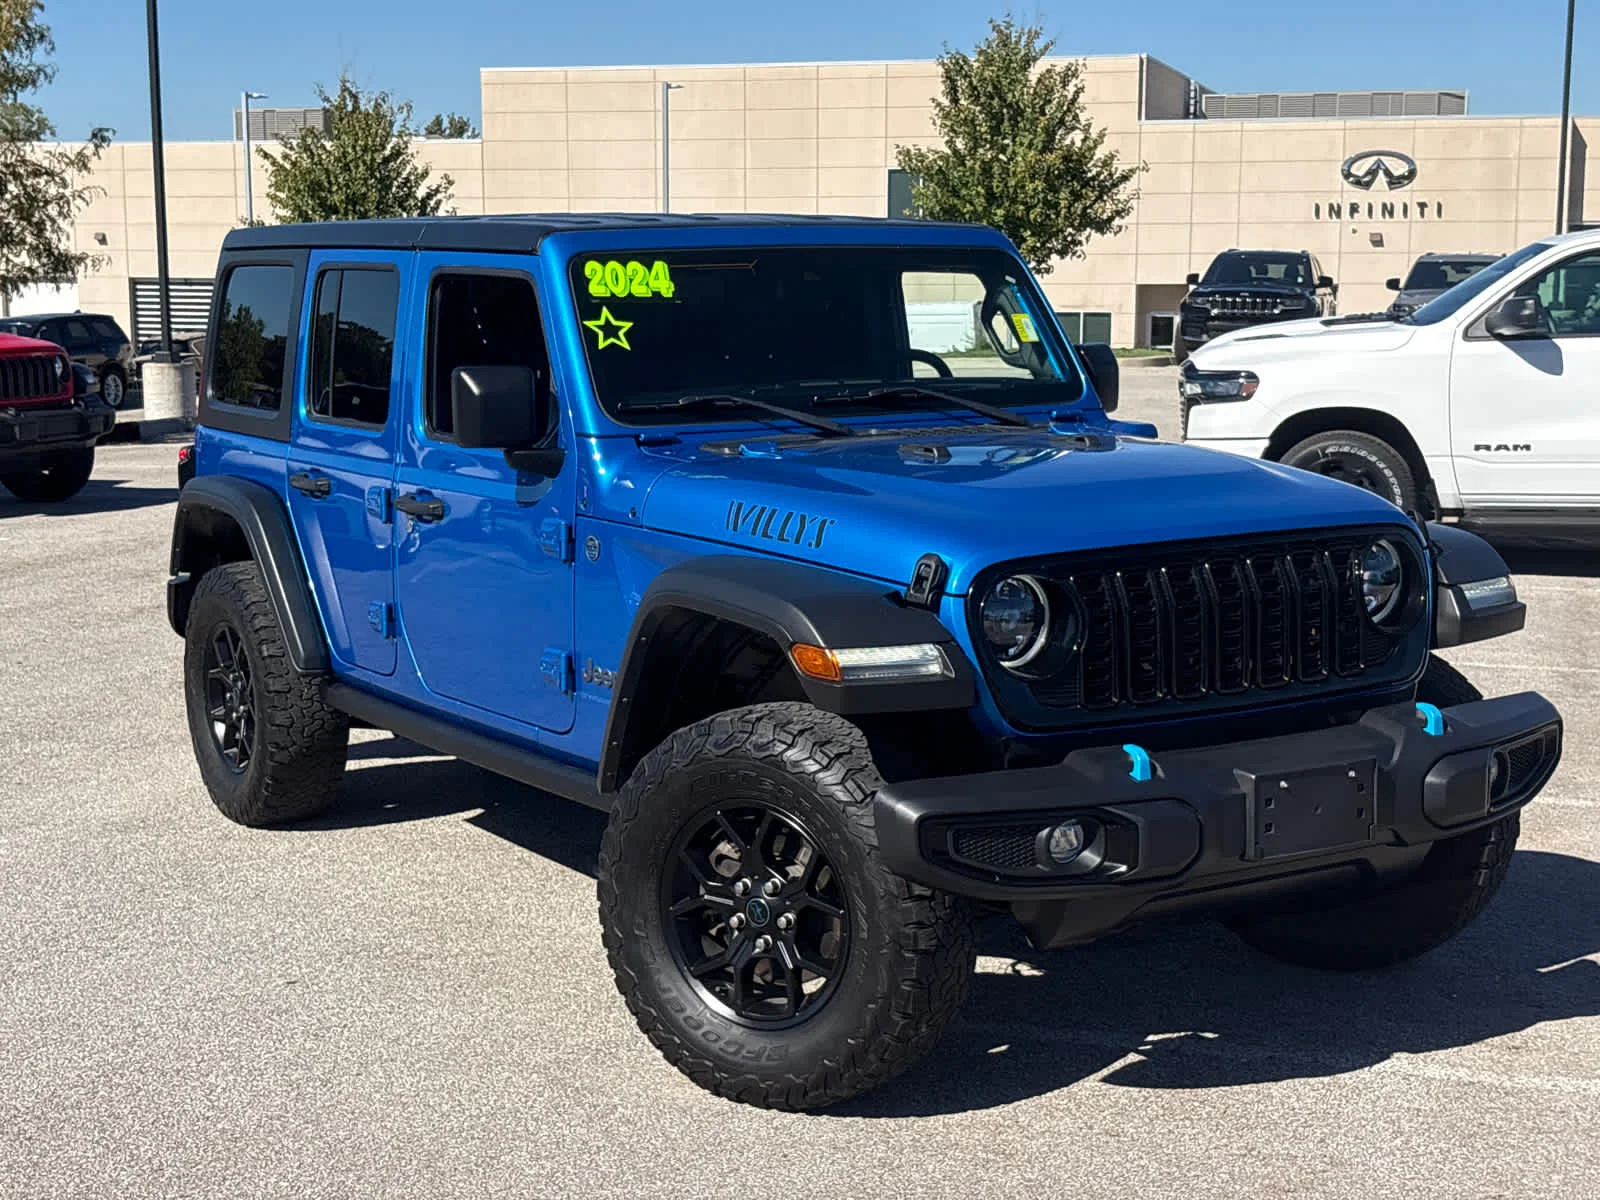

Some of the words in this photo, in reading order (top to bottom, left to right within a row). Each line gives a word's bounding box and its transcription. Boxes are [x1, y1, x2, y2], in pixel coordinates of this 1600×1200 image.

[1314, 201, 1443, 219] INFINITI
[584, 260, 675, 297] 2024
[1473, 443, 1532, 452] RAM
[726, 500, 835, 549] WILLYS
